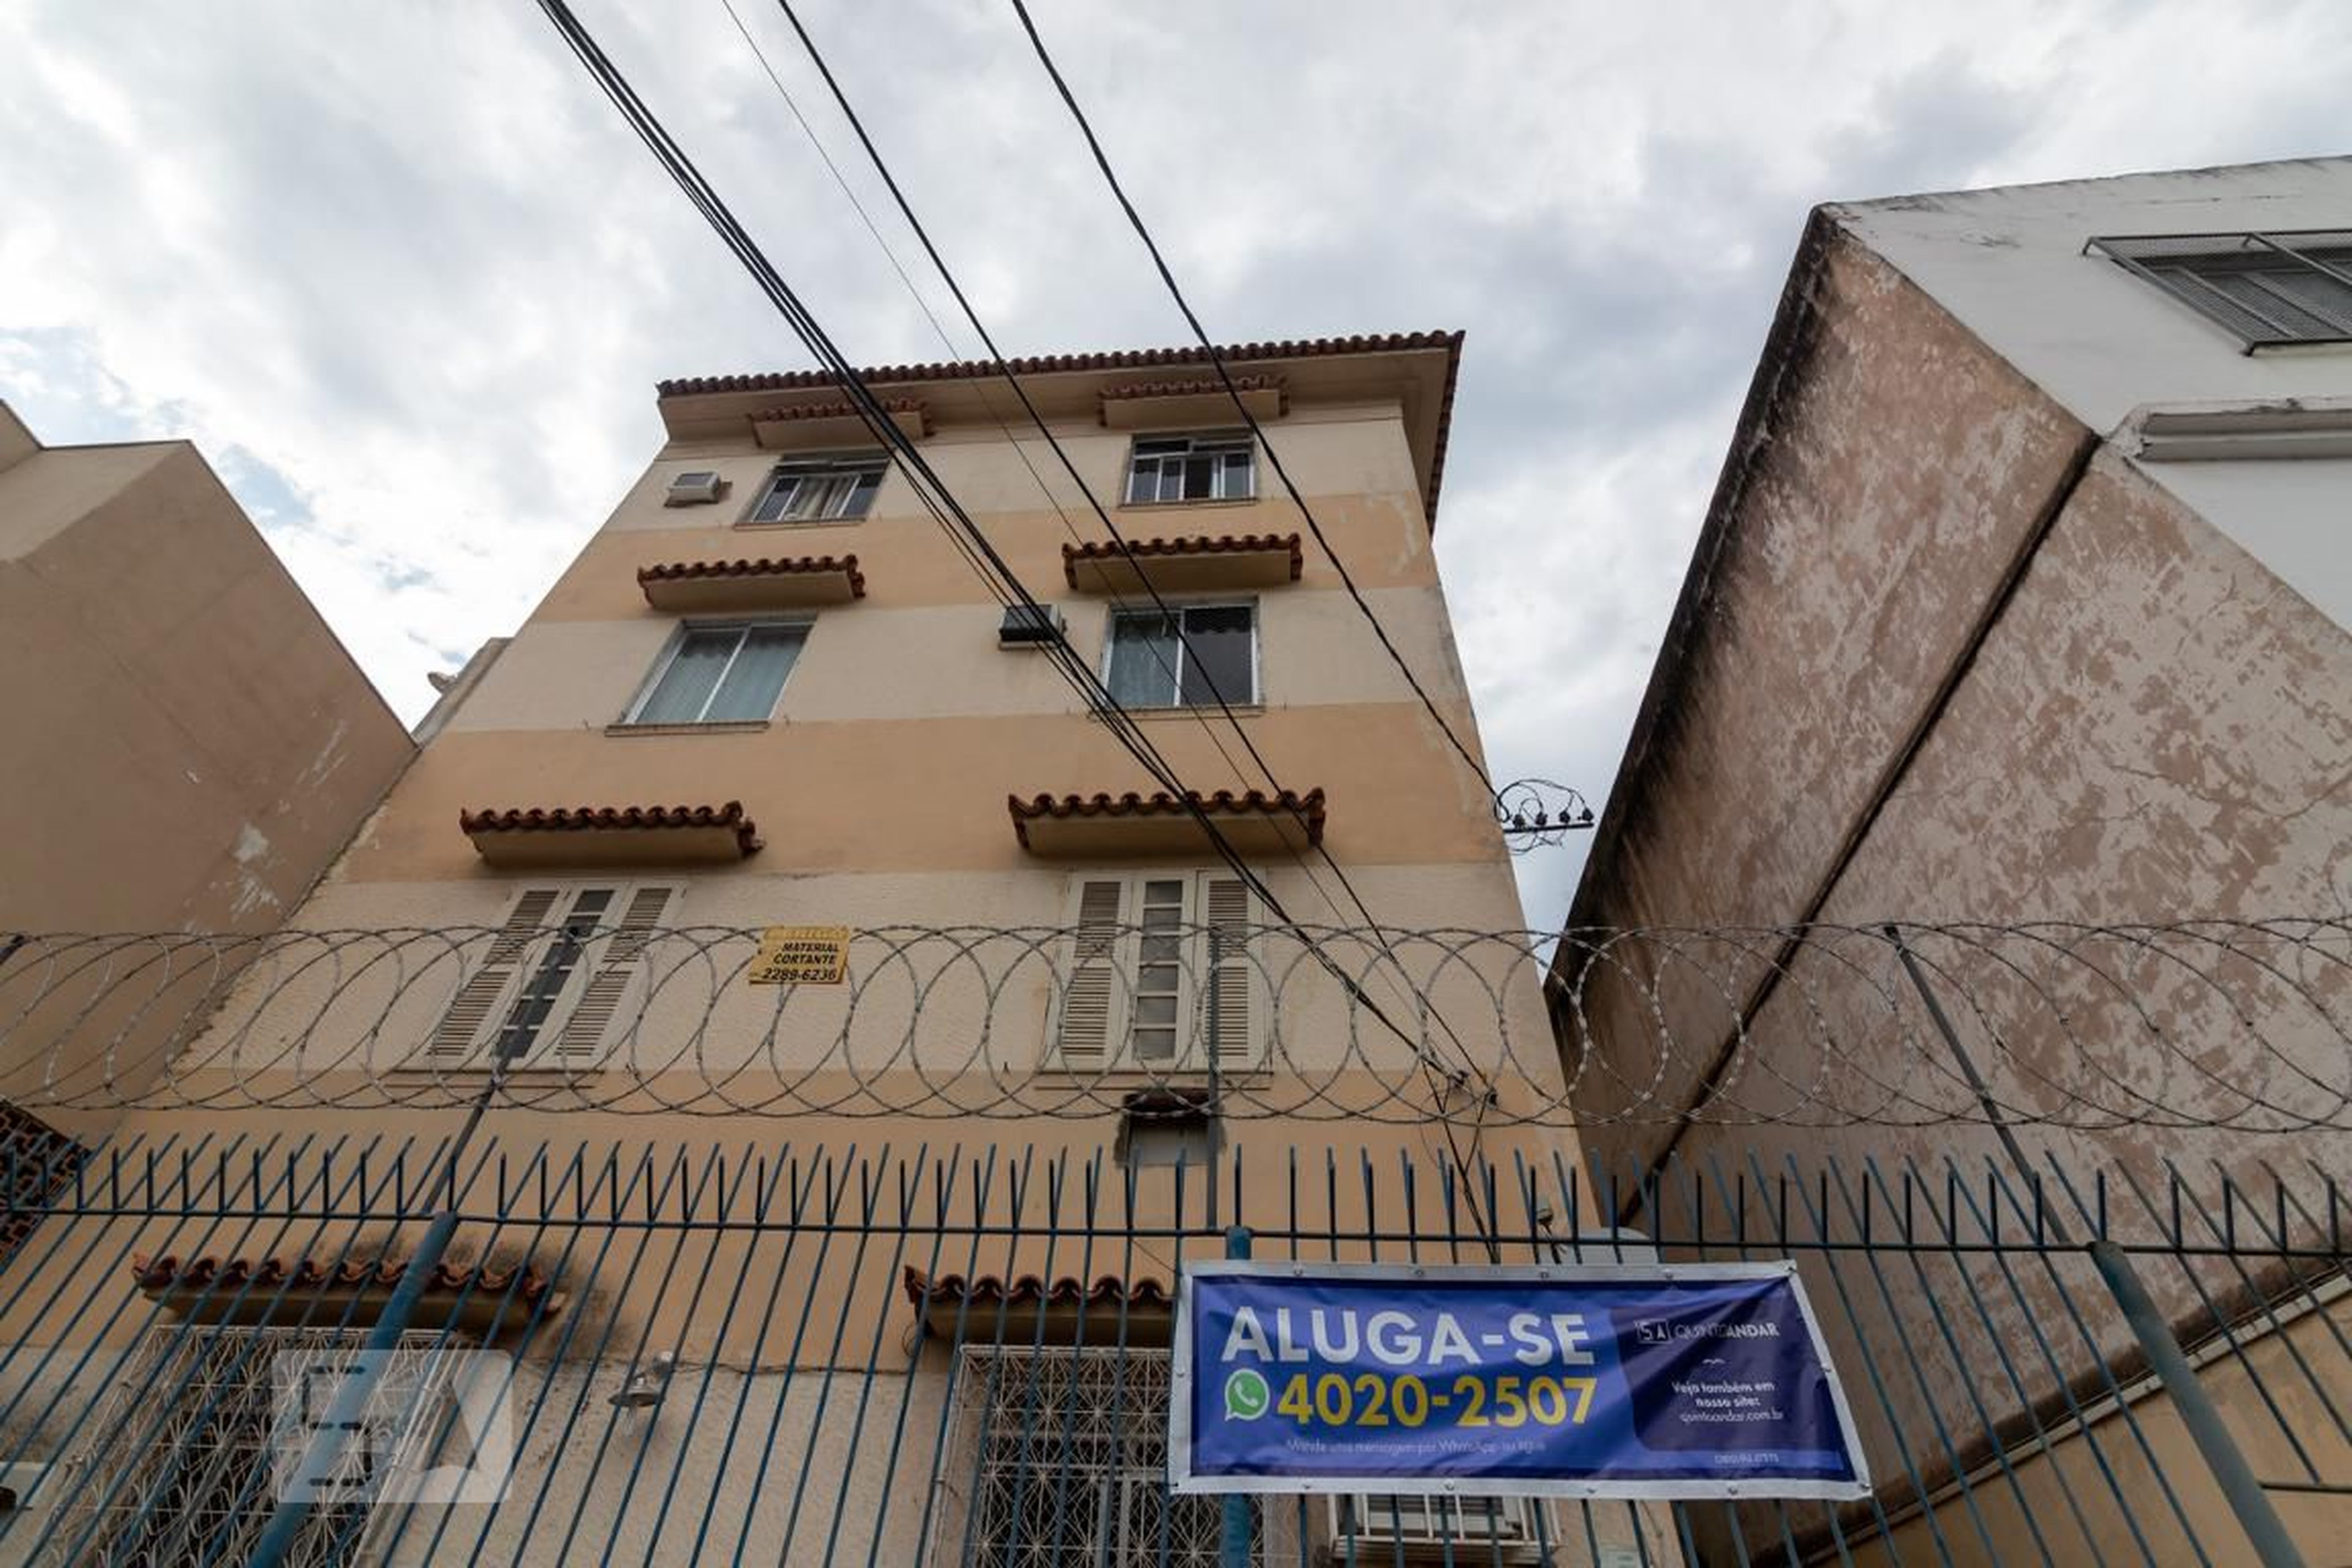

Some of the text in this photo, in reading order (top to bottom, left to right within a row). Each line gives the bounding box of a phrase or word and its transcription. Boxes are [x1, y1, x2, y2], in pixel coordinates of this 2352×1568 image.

[782, 942, 840, 952] MATERIAL
[773, 952, 838, 965] CORTANTE
[1221, 1306, 1595, 1366] ALUGA-SE
[1754, 1381, 1775, 1391] em
[1277, 1373, 1597, 1427] 4020-2507
[1695, 1397, 1732, 1408] nosso
